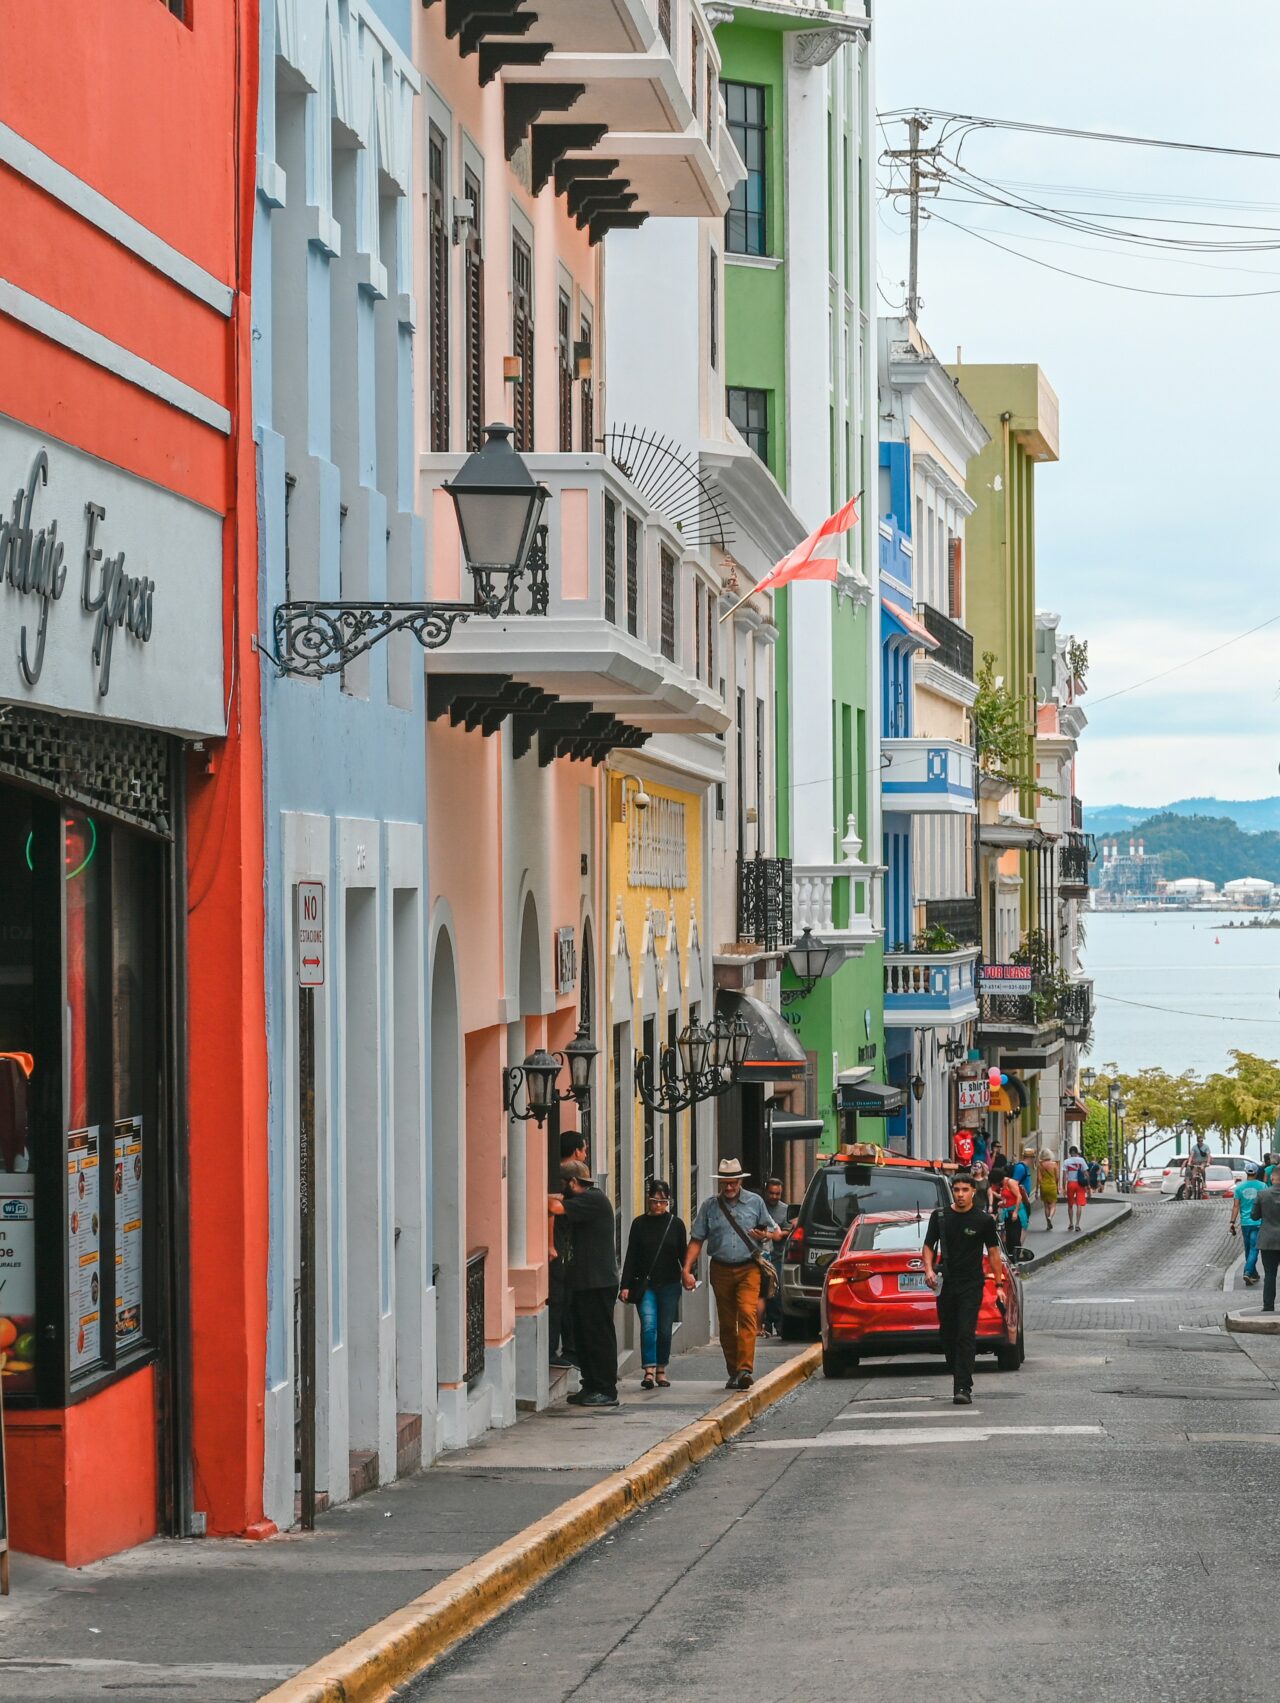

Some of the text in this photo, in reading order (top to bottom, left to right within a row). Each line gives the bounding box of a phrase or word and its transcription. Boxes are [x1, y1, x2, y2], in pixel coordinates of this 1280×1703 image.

[304, 895, 317, 920] NO
[300, 930, 322, 943] ESTACIONE
[985, 966, 1003, 978] FOR
[1004, 966, 1031, 979] LEASE
[960, 1092, 966, 1104] 4
[978, 1090, 990, 1103] 10
